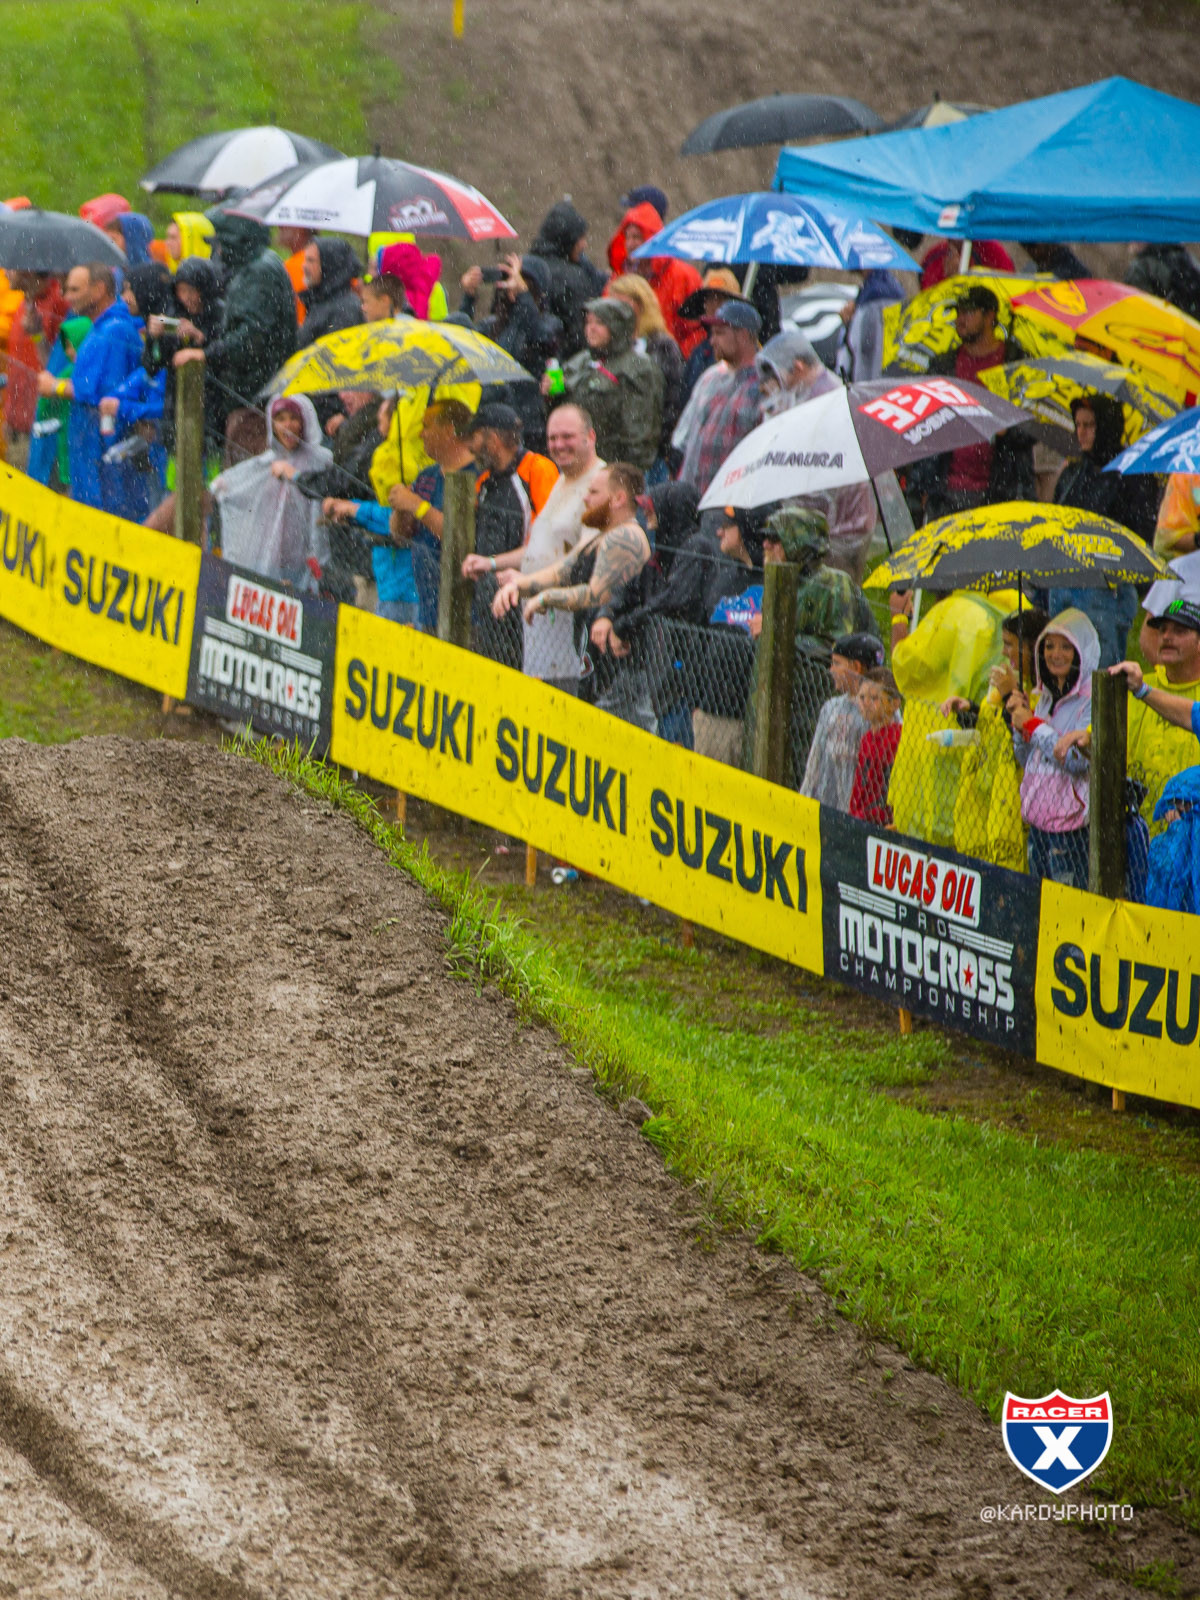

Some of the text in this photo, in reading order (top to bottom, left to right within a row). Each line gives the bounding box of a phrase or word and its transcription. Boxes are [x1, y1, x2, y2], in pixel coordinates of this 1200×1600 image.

[64, 547, 184, 646] SUZUKI
[231, 583, 299, 642] LUCAS OIL
[199, 634, 322, 721] MOTOCROSS
[345, 658, 475, 764] SUZUKI
[496, 717, 627, 835] SUZUKI
[650, 788, 808, 914] SUZUKI
[872, 844, 976, 920] LUCAS OIL
[839, 902, 1015, 1013] MOTOCROSS
[898, 903, 947, 937] PRO
[839, 952, 1015, 1033] CHAMPIONSHIP
